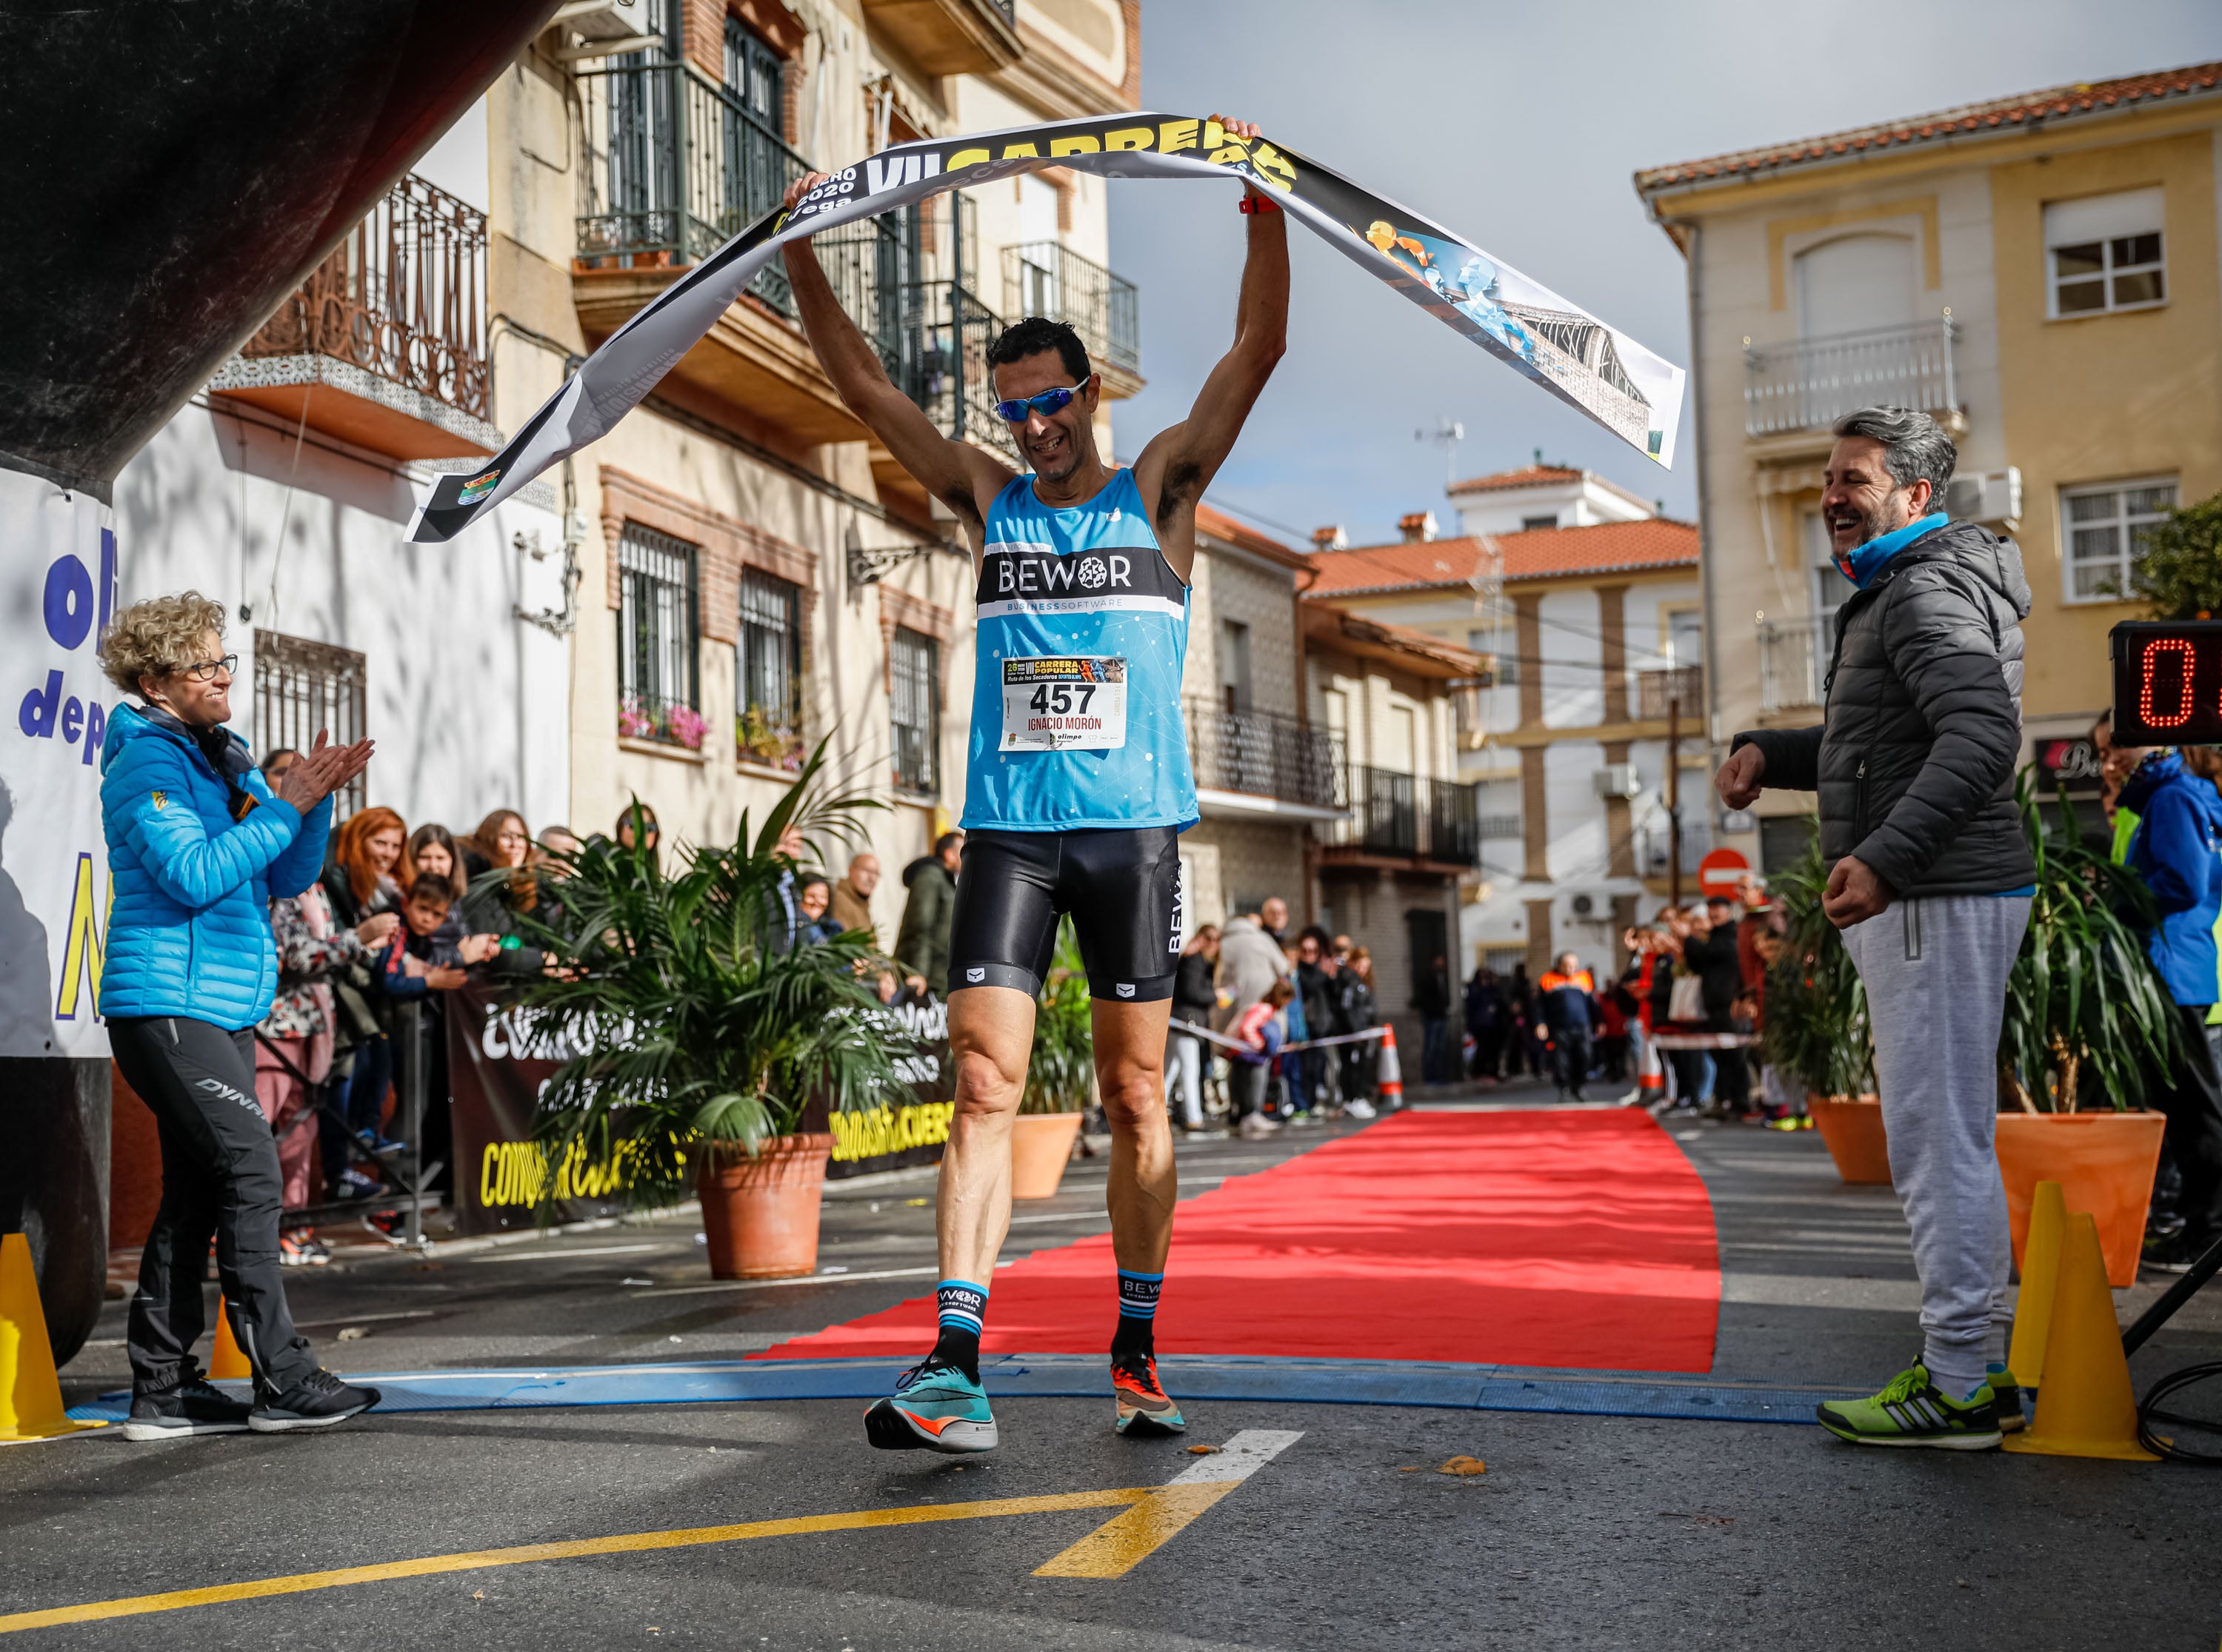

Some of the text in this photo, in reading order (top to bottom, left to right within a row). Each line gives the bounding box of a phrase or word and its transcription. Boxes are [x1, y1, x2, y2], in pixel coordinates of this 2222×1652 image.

[867, 153, 940, 195] VII
[795, 182, 854, 208] 2020
[1007, 661, 1078, 675] 26 VII CARRERA
[1030, 684, 1096, 715] 457
[19, 669, 105, 766] dep
[1028, 715, 1101, 731] IGNACIO MORÓN
